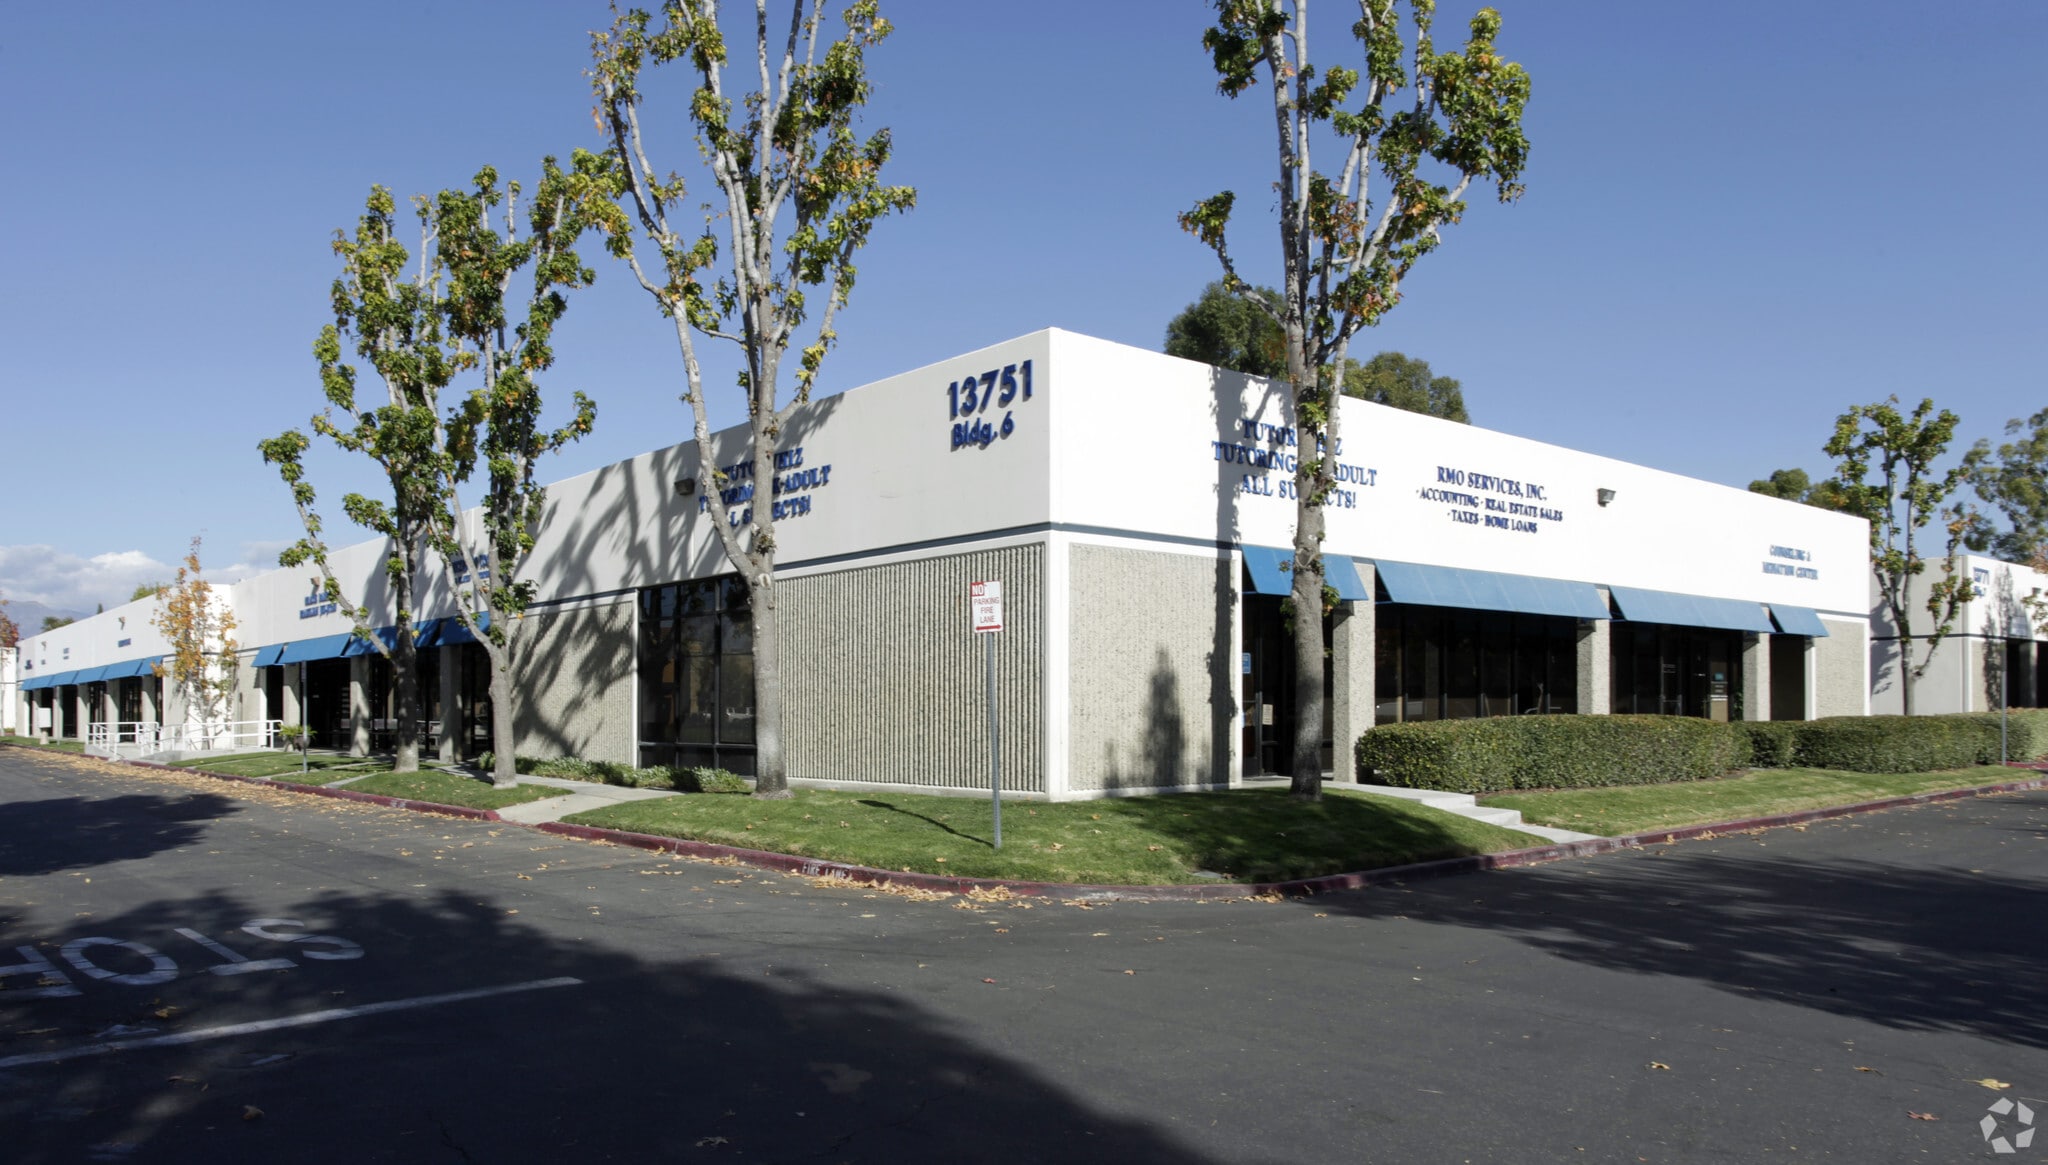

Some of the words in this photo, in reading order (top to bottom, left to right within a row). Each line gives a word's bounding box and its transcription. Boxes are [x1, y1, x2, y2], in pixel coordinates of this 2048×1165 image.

[948, 359, 1032, 422] 13751
[951, 418, 998, 451] Bldg.
[1000, 411, 1014, 439] 6
[1212, 441, 1298, 473] TUTORING
[1240, 473, 1273, 497] ALL
[1437, 466, 1465, 486] RMO
[1468, 472, 1524, 499] SERVICES,
[1526, 483, 1547, 501] INC.
[1420, 487, 1479, 508] ACCOUNTING
[1485, 498, 1507, 513] REAL
[1509, 502, 1538, 518] ESTATE
[1540, 507, 1563, 522] SALES
[1451, 509, 1479, 525] TAXES
[972, 584, 984, 596] NO
[980, 606, 994, 614] FIRE
[980, 615, 996, 623] LANE
